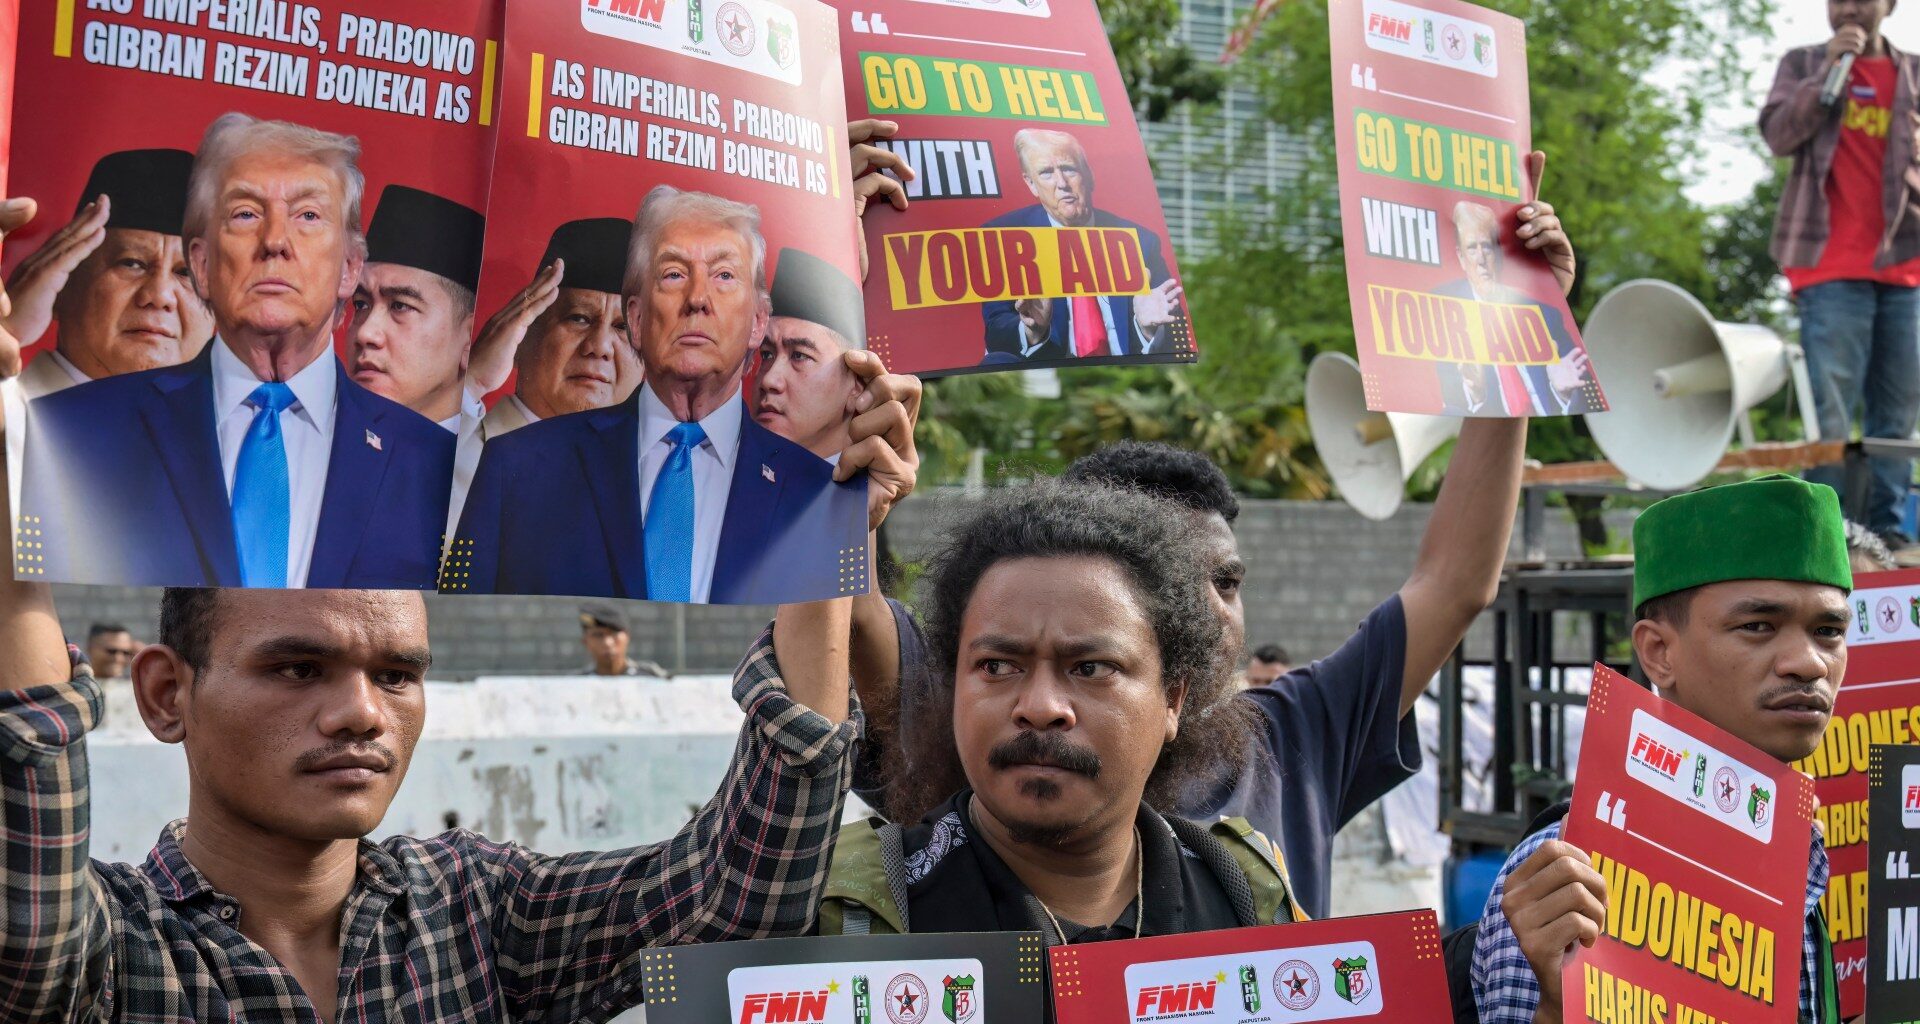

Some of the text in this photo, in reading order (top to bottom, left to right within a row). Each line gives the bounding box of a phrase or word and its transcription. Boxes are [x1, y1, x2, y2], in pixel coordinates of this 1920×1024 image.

[337, 12, 475, 75] PRABOWO
[1368, 13, 1411, 41] FMN
[83, 20, 471, 124] GIBRAN REZIM BONEKA AS
[863, 55, 1105, 123] GO TO HELL
[551, 59, 823, 154] AS IMPERIALIS, PRABOWO
[549, 106, 827, 195] GIBRAN REZIM BONEKA AS
[875, 140, 999, 197] WITH
[1356, 112, 1520, 198] GO TO HELL
[1361, 197, 1440, 265] WITH
[888, 229, 1146, 306] YOUR AID
[1371, 286, 1555, 364] YOUR AID
[1632, 732, 1683, 777] FMN
[1792, 706, 1920, 780] NDONE
[1813, 799, 1868, 848] ARU
[1905, 785, 1920, 808] F
[1821, 870, 1868, 944] AR
[1886, 906, 1920, 982] M
[739, 990, 829, 1024] FMN
[1135, 980, 1217, 1016] FMN
[1136, 1015, 1155, 1023] FRONT
[1188, 1009, 1216, 1017] NASIONAL
[1584, 961, 1668, 1024] HARUS
